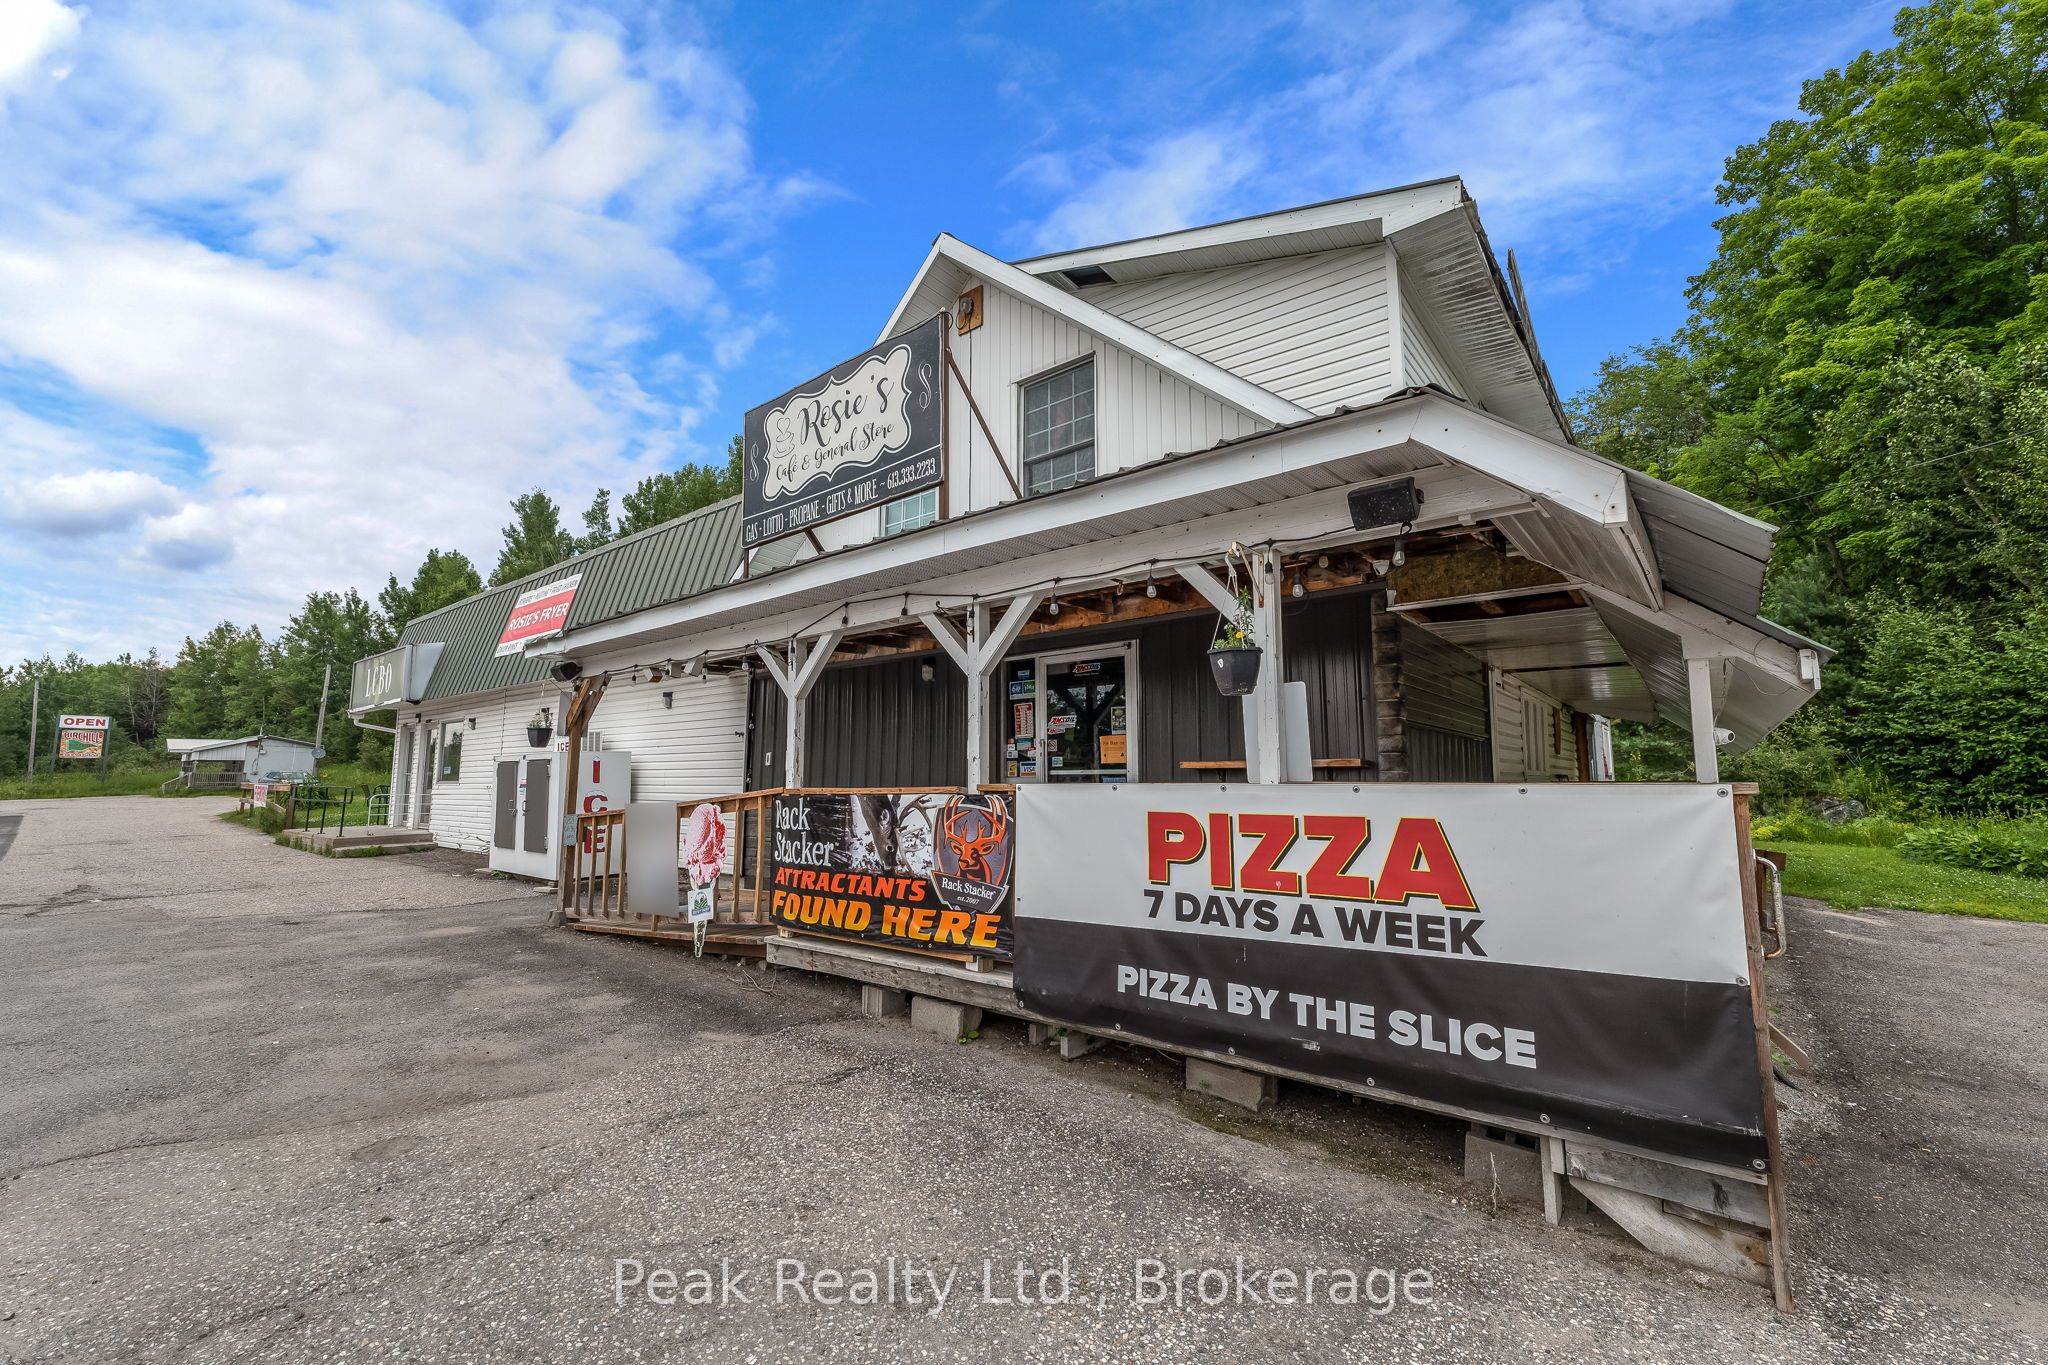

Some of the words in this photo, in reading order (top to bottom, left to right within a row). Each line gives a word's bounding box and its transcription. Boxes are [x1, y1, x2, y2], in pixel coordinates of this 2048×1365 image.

[797, 375, 895, 447] Rosie's
[776, 456, 798, 482] Café
[801, 455, 810, 471] &
[815, 427, 858, 469] General
[860, 422, 894, 450] Store
[745, 523, 758, 542] GAS
[763, 514, 784, 537] LOTTO
[789, 500, 820, 528] PROPANE
[826, 490, 846, 515] GIFTS
[848, 488, 852, 504] &
[854, 478, 879, 505] MORE
[887, 457, 936, 490] 613.333.2233
[508, 610, 540, 631] ROSIE'S
[539, 603, 568, 622] FRYER
[365, 663, 392, 697] LCBO
[64, 717, 106, 726] OPEN
[775, 797, 811, 830] Rack
[774, 831, 832, 866] Stacker
[1147, 811, 1480, 913] PIZZA
[774, 867, 928, 901] ATTRACTANTS
[941, 877, 963, 893] Rack
[964, 883, 993, 900] Stacker
[772, 889, 872, 932] FOUND
[881, 904, 1001, 948] HERE
[1144, 889, 1164, 918] 7
[1175, 892, 1279, 933] DAYS
[1290, 903, 1324, 938] A
[1334, 906, 1488, 957] WEEK
[1117, 965, 1218, 1011] PIZZA
[1227, 982, 1280, 1020] BY
[1289, 993, 1376, 1040] THE
[1388, 1011, 1537, 1069] SLICE
